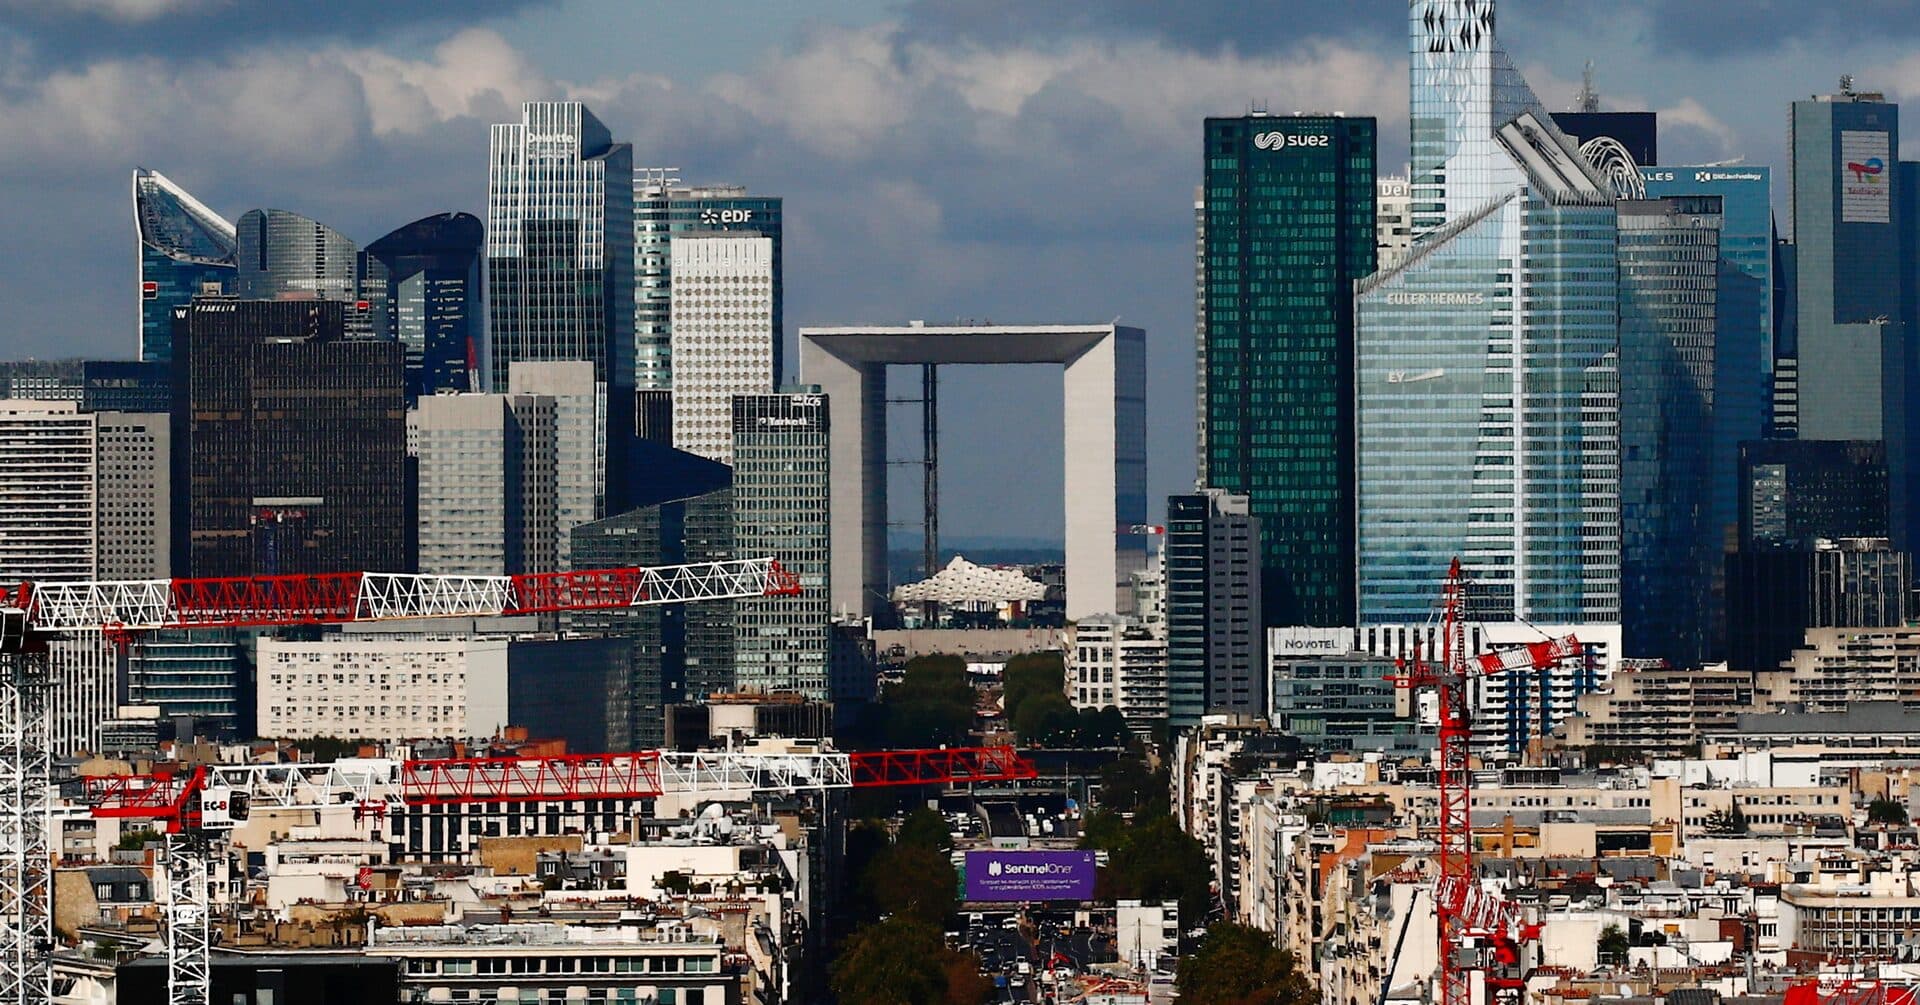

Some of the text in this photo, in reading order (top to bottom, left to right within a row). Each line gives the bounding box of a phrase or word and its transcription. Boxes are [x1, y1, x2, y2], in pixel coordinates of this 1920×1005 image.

[1287, 135, 1329, 147] suez
[1387, 292, 1484, 305] EULER HERMES
[175, 309, 187, 319] W
[1388, 371, 1406, 383] EY
[1284, 639, 1340, 649] NOVOTEL
[204, 801, 227, 811] EC-B
[1004, 863, 1072, 875] SentinelOne
